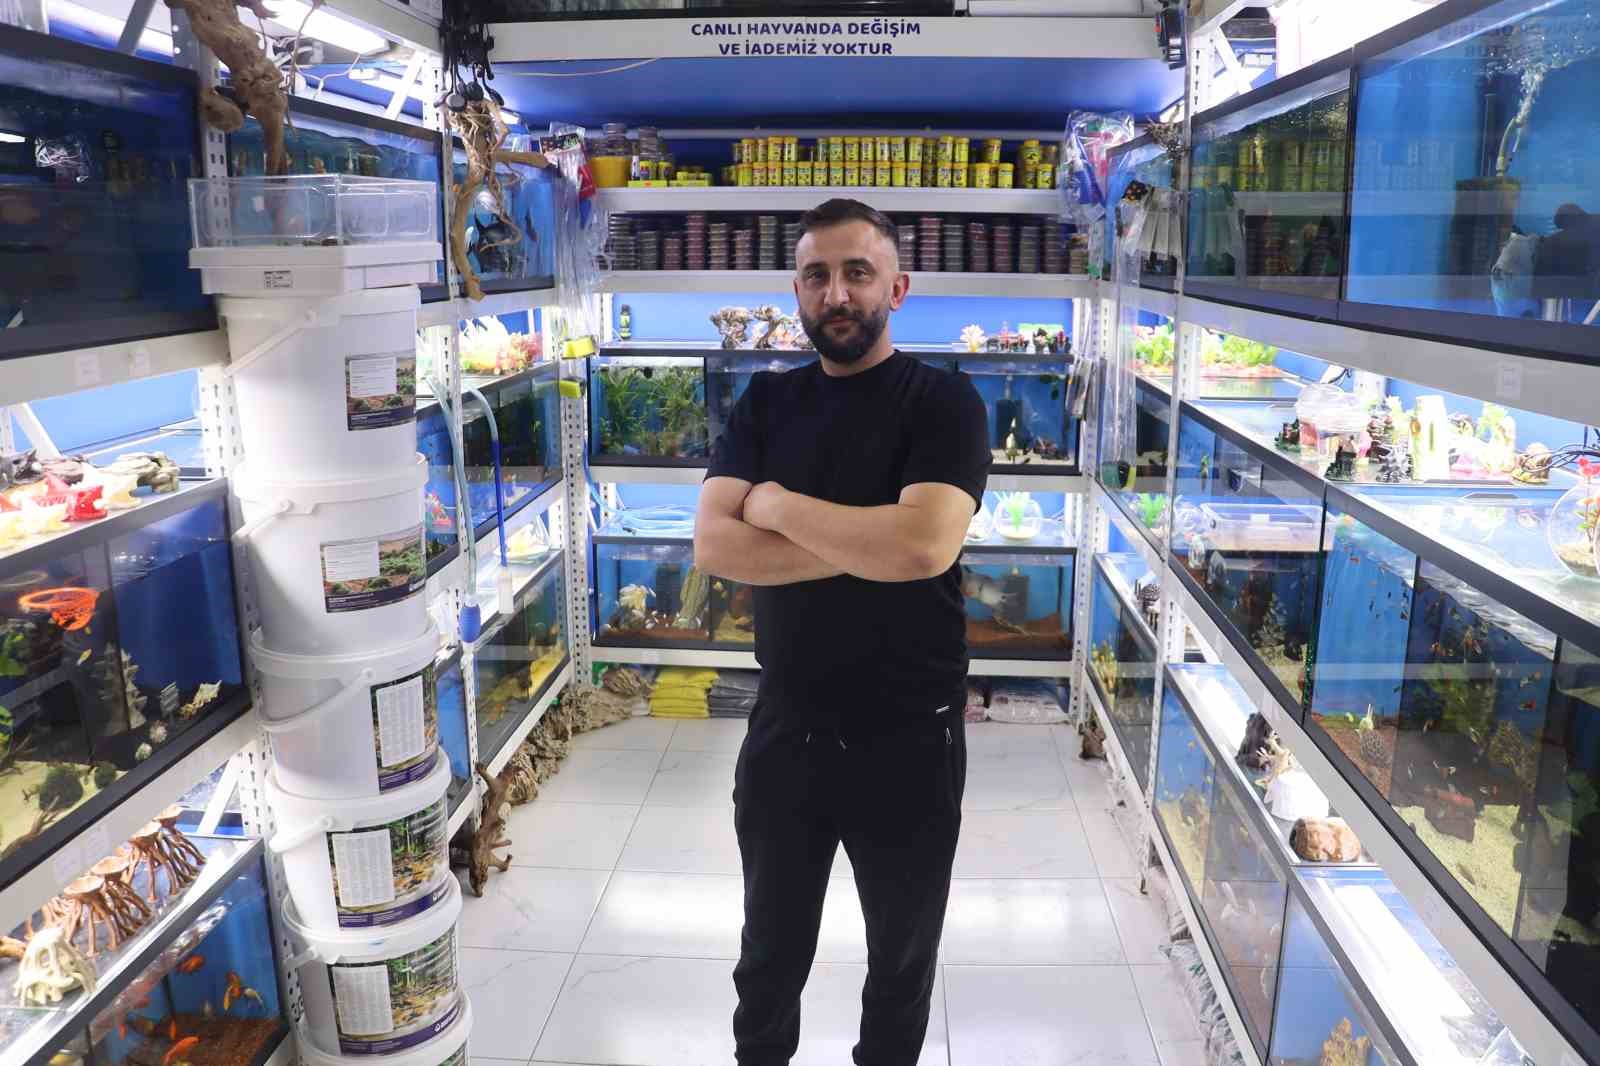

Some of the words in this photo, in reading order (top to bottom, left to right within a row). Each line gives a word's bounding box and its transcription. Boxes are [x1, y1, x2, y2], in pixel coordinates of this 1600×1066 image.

[691, 22, 742, 36] CANLI
[746, 22, 843, 36] HAYVANDA
[847, 18, 921, 38] DEĞİŞİM
[718, 43, 741, 56] VE
[745, 39, 818, 56] İADEMİZ
[821, 42, 893, 55] YOKTUR
